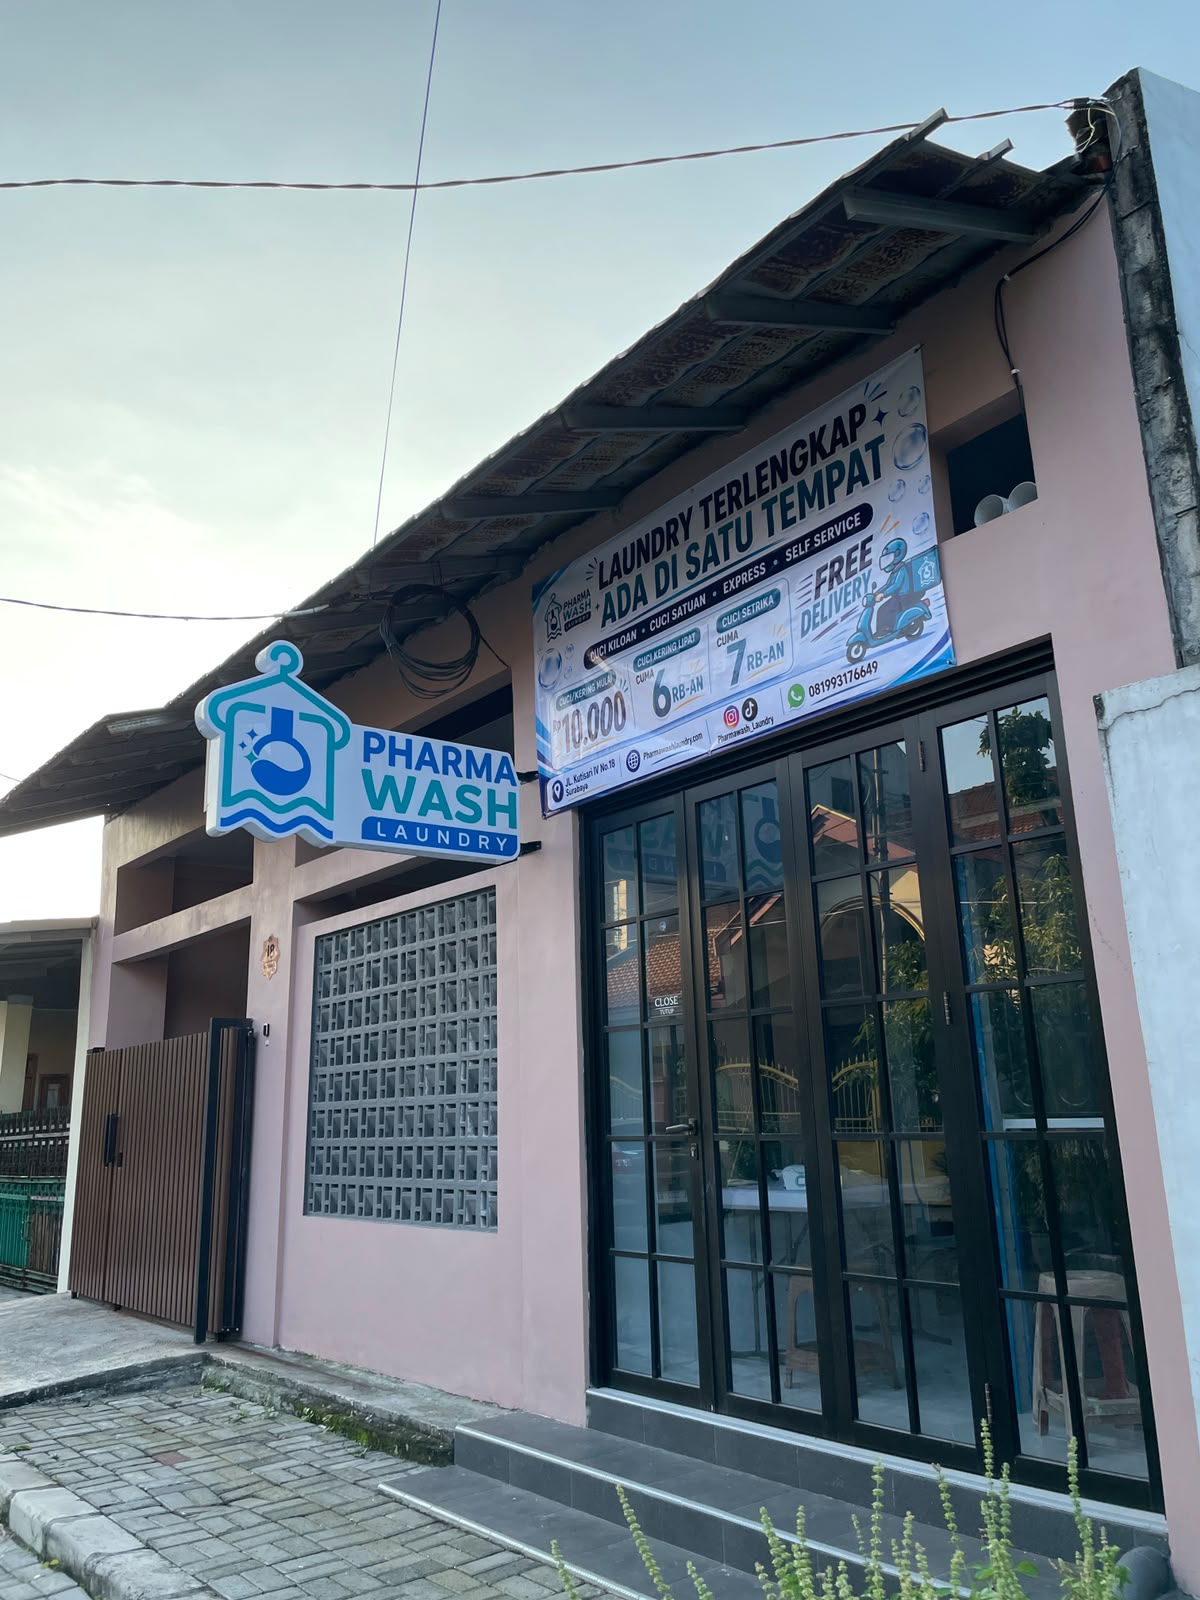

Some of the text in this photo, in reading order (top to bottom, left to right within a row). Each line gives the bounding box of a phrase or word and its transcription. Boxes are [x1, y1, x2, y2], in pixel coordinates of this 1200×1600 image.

[599, 403, 867, 590] LAUNDRY TERLENGKAP
[601, 434, 886, 628] ADA DI SATU TEMPAT
[814, 534, 874, 601] FREE
[563, 588, 591, 609] PHARMA
[590, 512, 861, 661] CUCI KILOAN CUCI SATUAN EXPRESS SELF SERVICE
[800, 569, 872, 639] DELIVERY
[563, 598, 591, 621] WASH
[722, 595, 774, 628] CUCI SETRIKA
[637, 632, 696, 668] CUCI KERING LIPAT
[717, 630, 739, 648] CUMA
[636, 669, 654, 685] CUMA
[726, 638, 785, 687] 7 RB-AN
[808, 661, 878, 697] 081993176649
[653, 668, 704, 718] 6 RB-AN
[717, 716, 774, 744] Pharmawash_Laundry
[363, 731, 517, 786] PHARMA
[361, 768, 517, 830] WASH
[565, 783, 589, 797] Surabaya
[376, 821, 508, 851] LAUNDRY
[654, 995, 679, 1007] CLOSE
